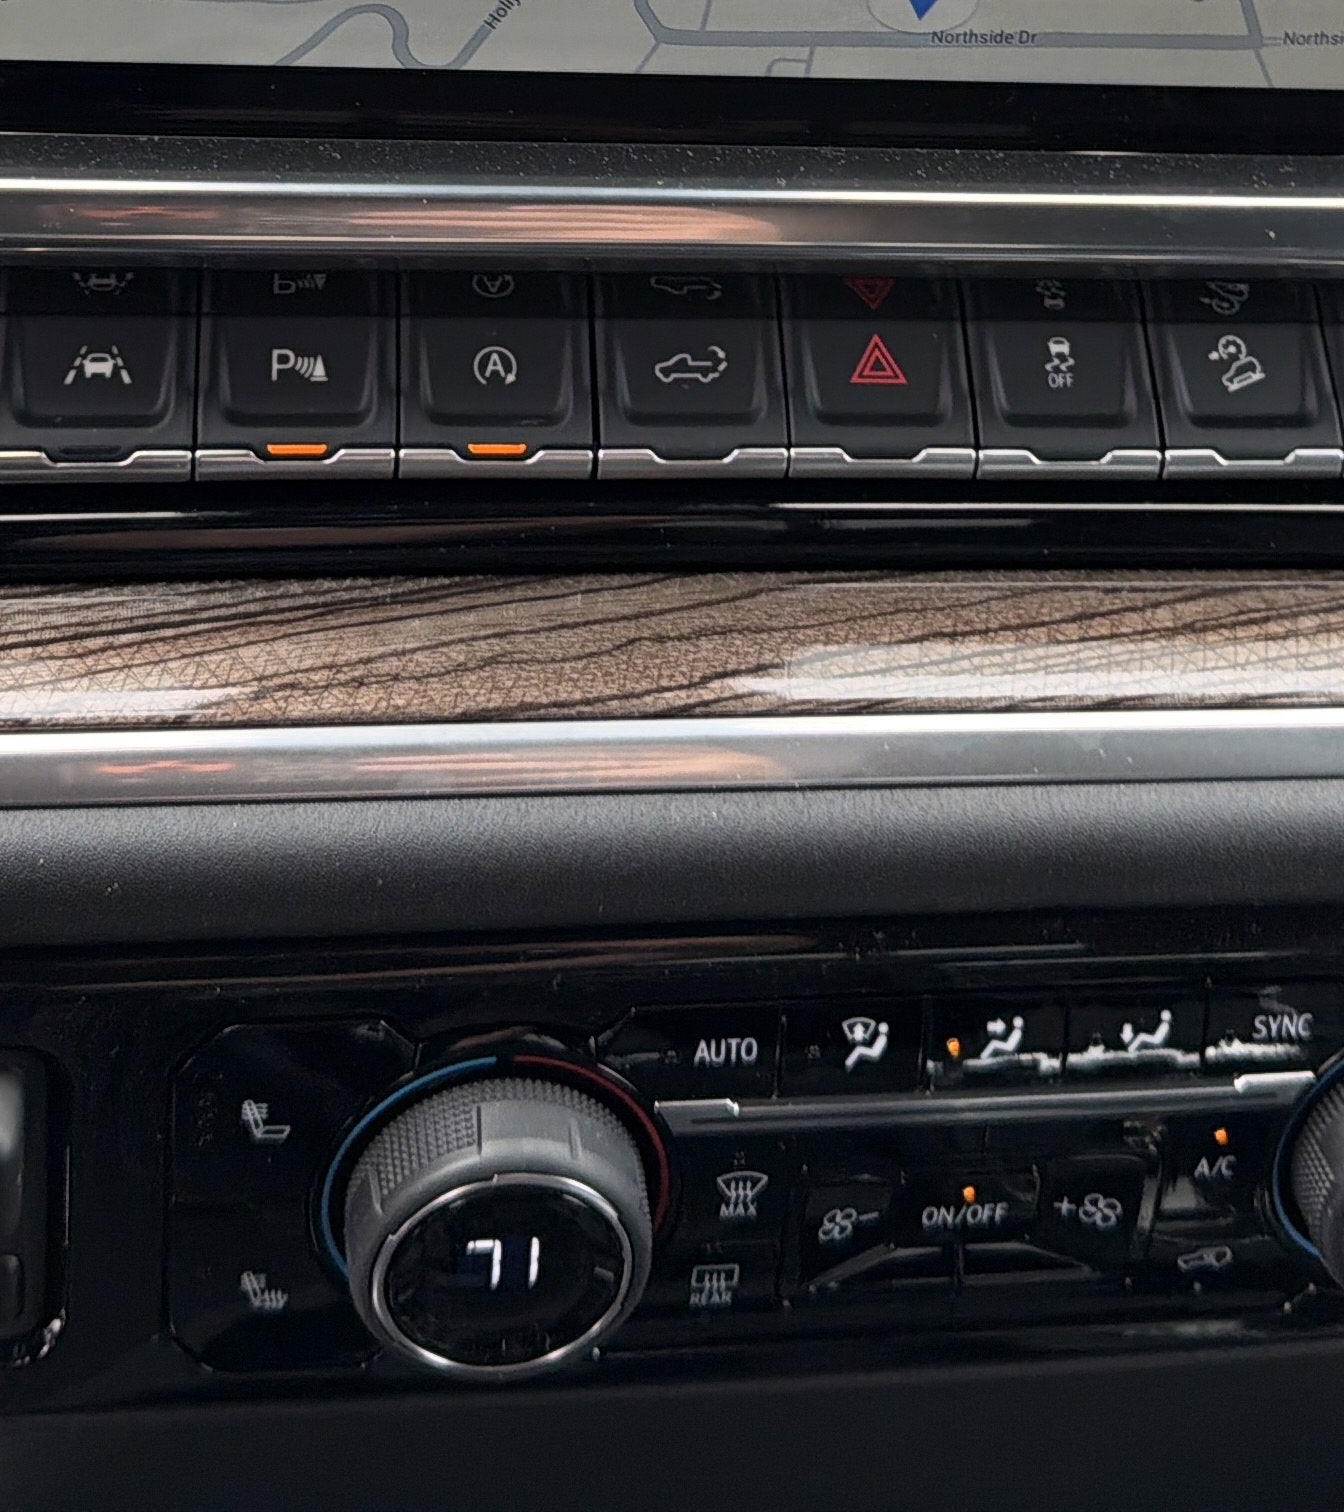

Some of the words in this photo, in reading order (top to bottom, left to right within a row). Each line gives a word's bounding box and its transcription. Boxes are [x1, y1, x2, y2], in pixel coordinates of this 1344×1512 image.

[931, 30, 1014, 46] Northside
[1017, 30, 1037, 46] Dr
[1048, 373, 1074, 388] OFF
[1252, 1013, 1313, 1038] SYNC
[694, 1038, 758, 1067] AUTO
[1194, 1156, 1237, 1178] A/C
[719, 1202, 758, 1219] MAX
[922, 1202, 1008, 1230] ON/OFF
[466, 1236, 541, 1289] 71
